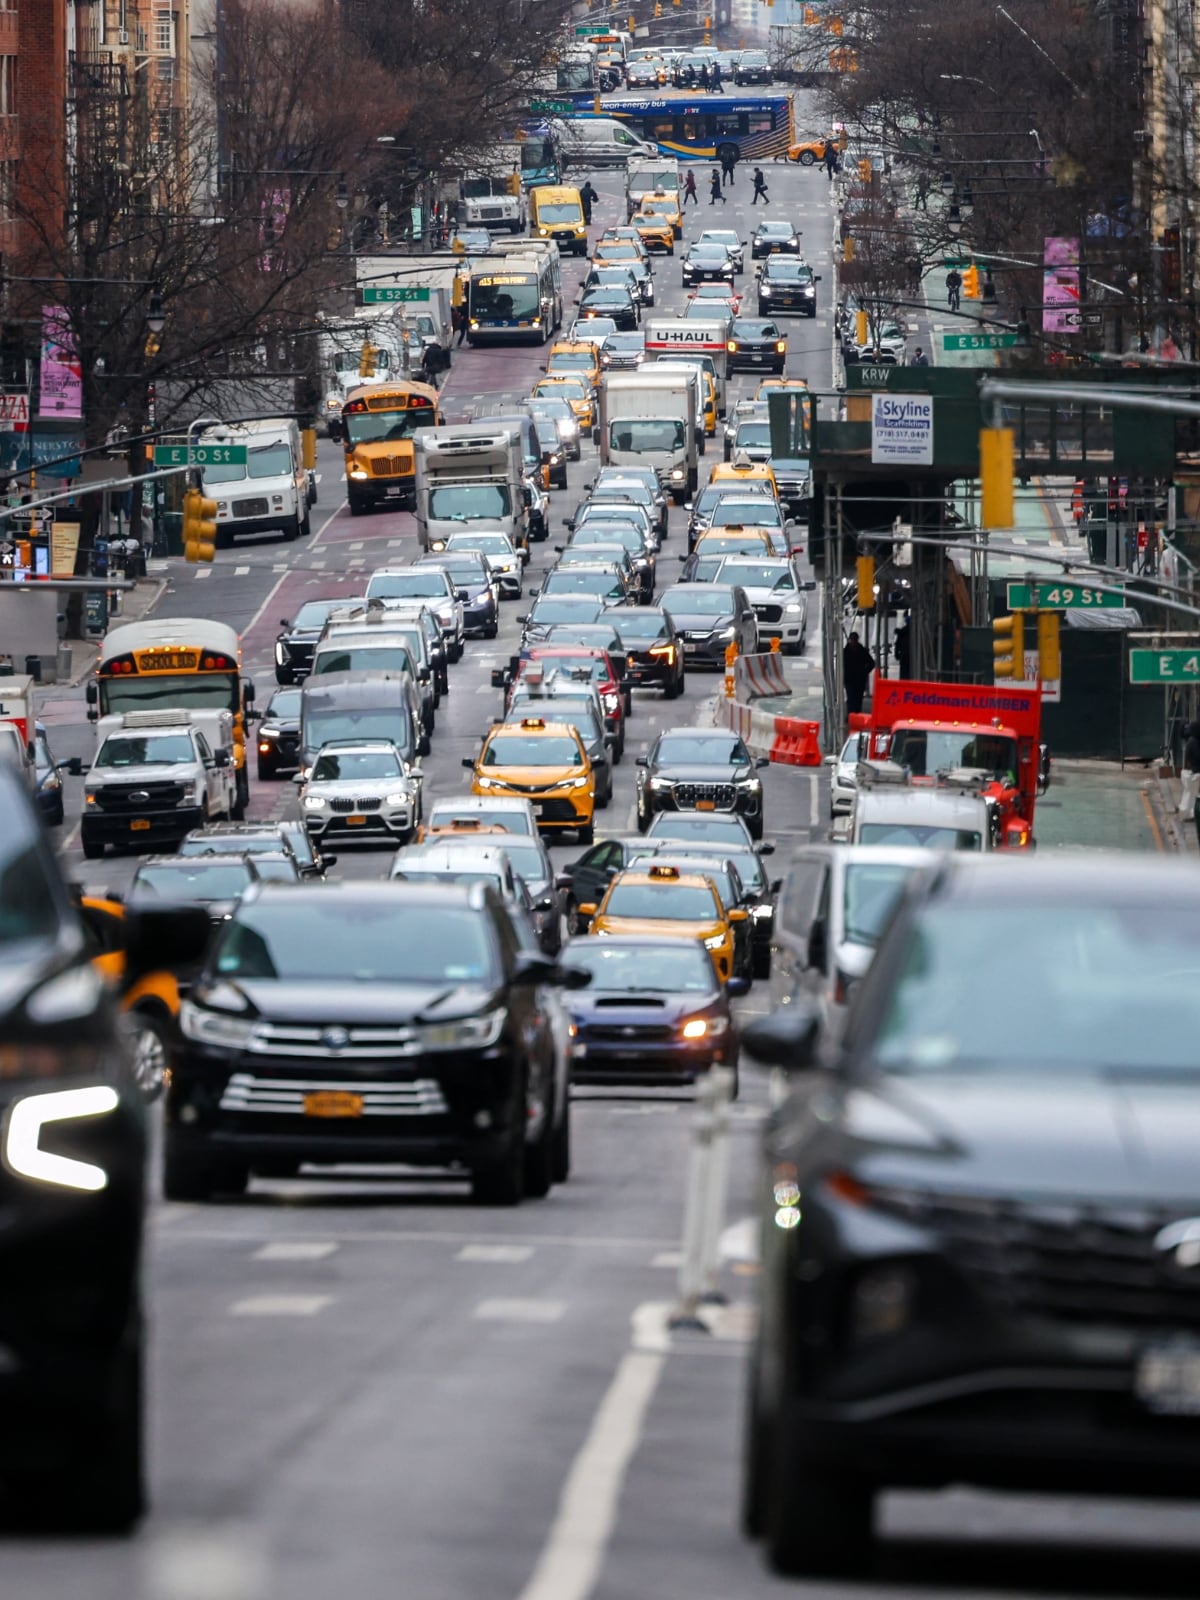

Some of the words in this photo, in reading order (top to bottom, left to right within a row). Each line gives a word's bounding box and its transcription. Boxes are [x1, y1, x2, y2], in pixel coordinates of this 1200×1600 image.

[376, 290, 383, 300] E
[386, 290, 401, 300] 52
[405, 290, 418, 300] St
[657, 332, 713, 342] U-HAUL
[958, 337, 967, 348] E
[861, 368, 890, 380] KRW
[883, 401, 930, 420] Skyline
[171, 450, 180, 461] E
[213, 450, 231, 461] St
[1047, 589, 1074, 604] 49
[1081, 589, 1103, 604] St
[1159, 656, 1173, 676] E
